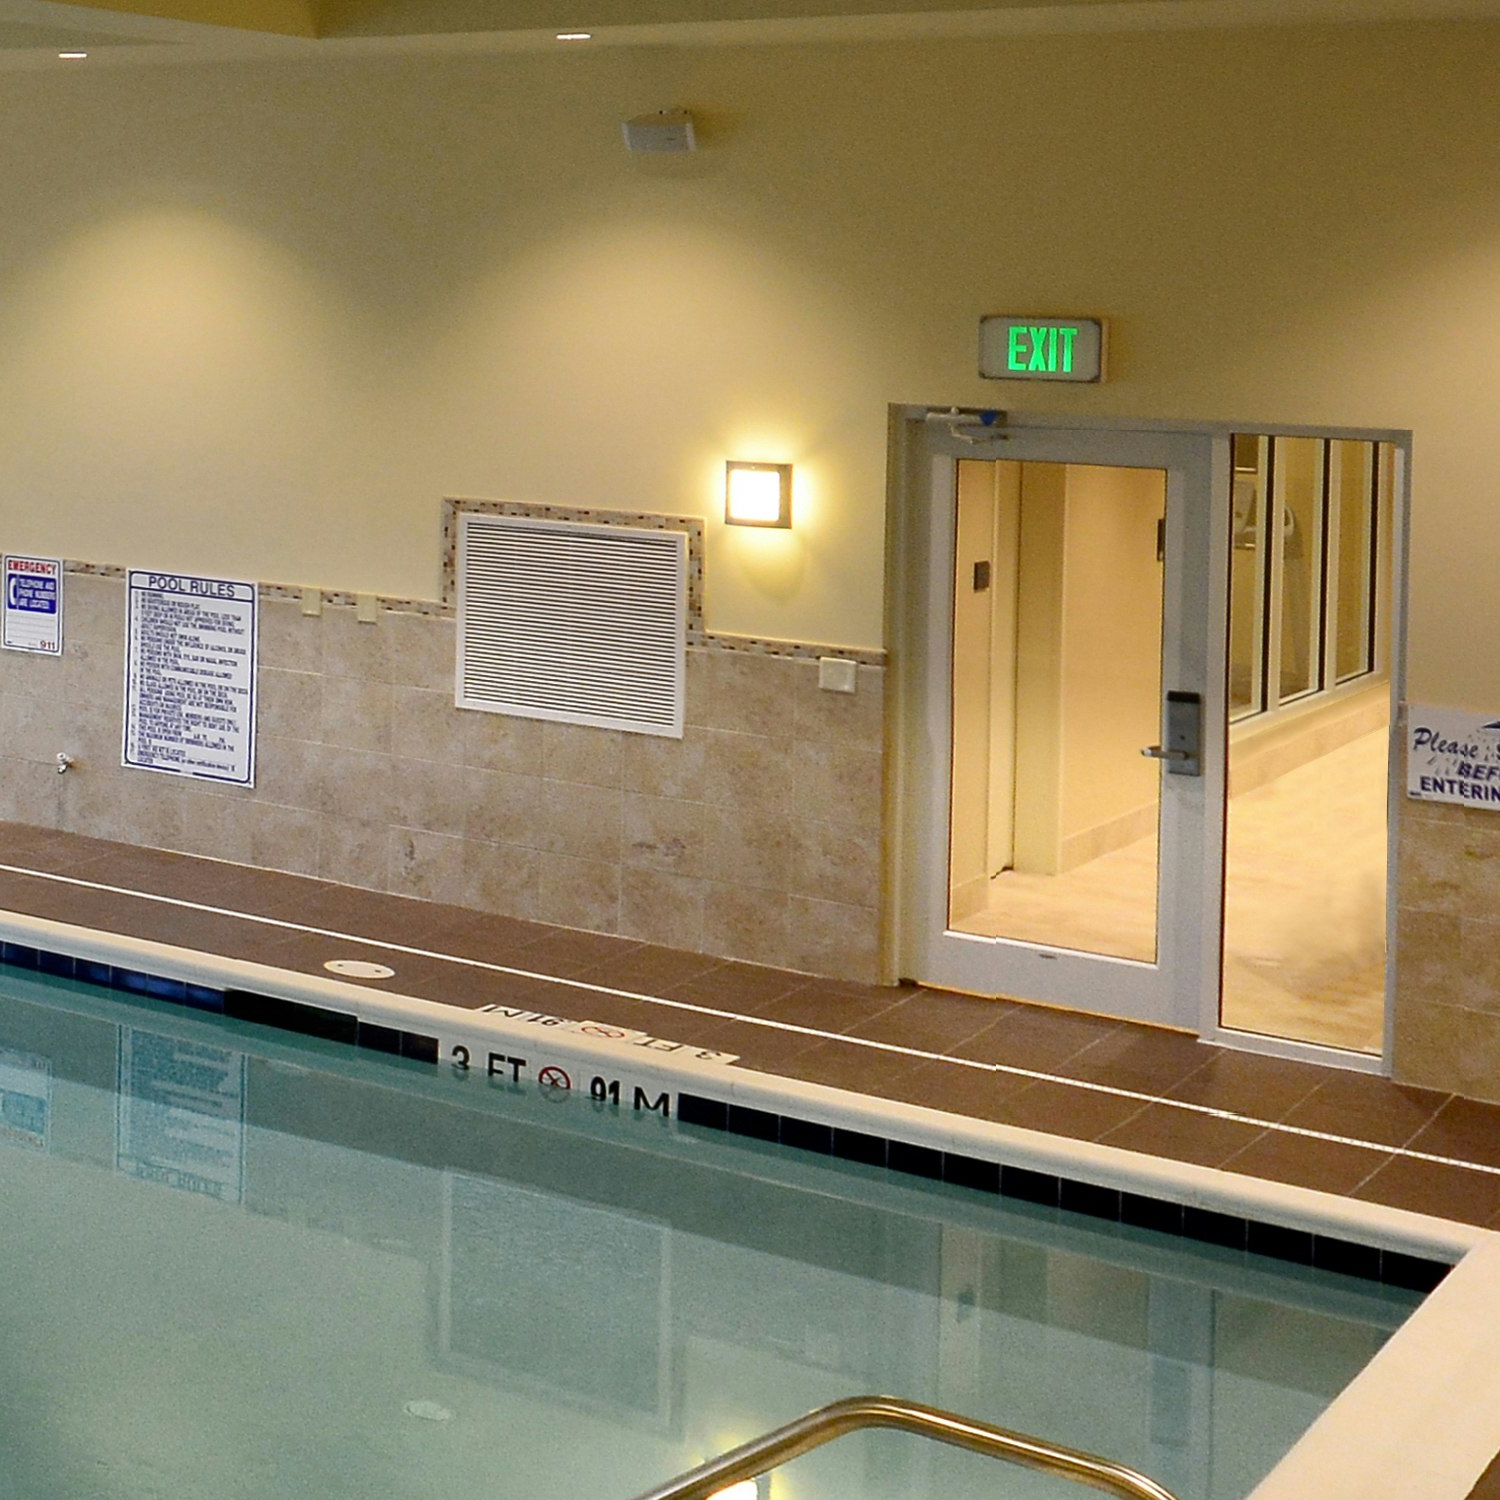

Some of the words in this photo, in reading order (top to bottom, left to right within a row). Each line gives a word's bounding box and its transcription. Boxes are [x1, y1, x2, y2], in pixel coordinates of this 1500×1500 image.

[1008, 326, 1078, 373] EXIT
[8, 560, 56, 575] EMERGENCY
[148, 576, 186, 592] POOL
[190, 580, 236, 598] RULES
[40, 640, 55, 650] 911
[1413, 727, 1479, 758] Please
[451, 1045, 470, 1070] 3
[488, 1052, 527, 1082] FT
[634, 1086, 670, 1117] M
